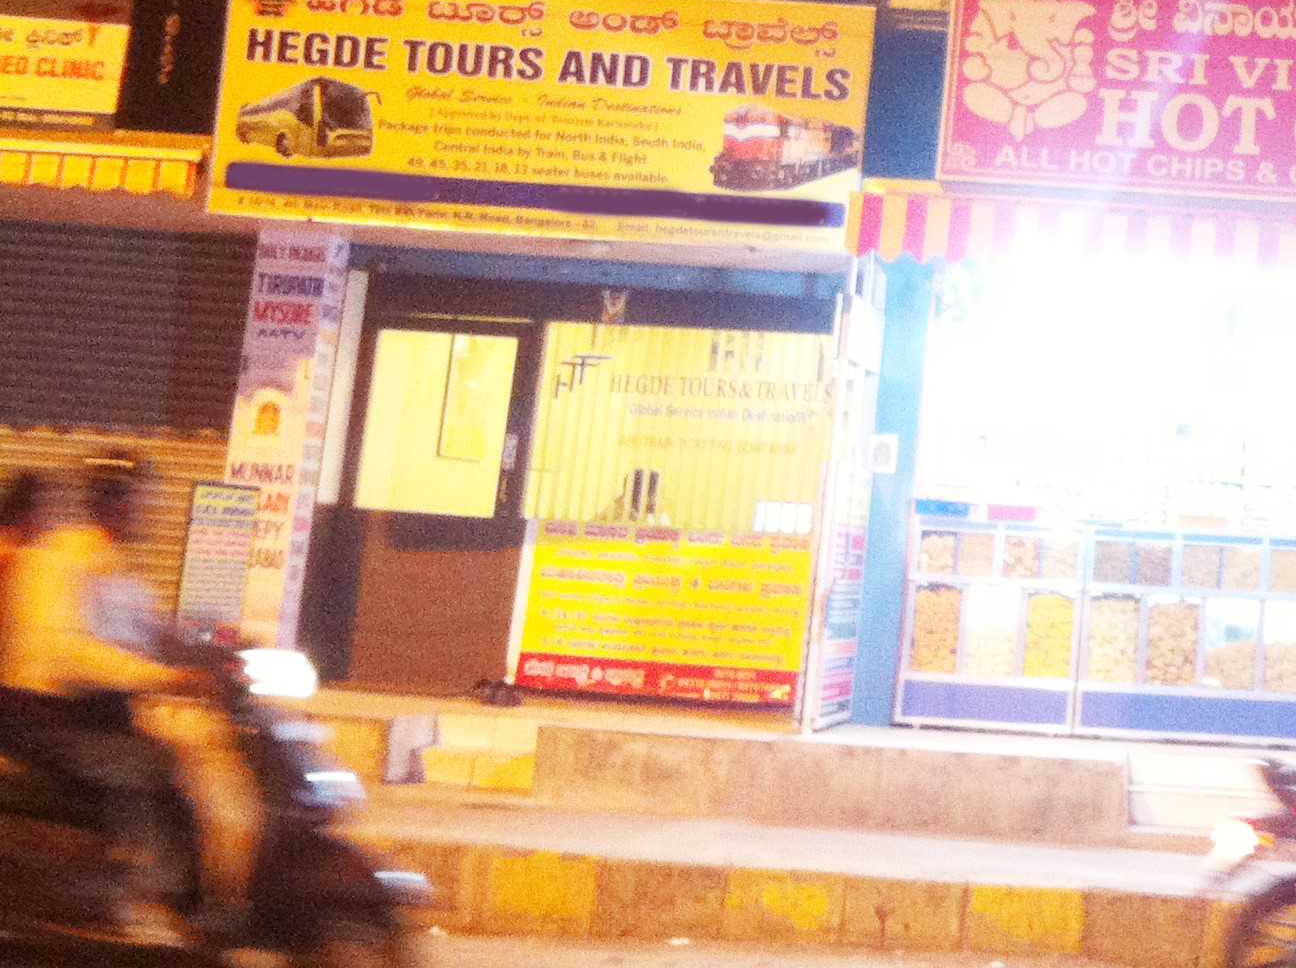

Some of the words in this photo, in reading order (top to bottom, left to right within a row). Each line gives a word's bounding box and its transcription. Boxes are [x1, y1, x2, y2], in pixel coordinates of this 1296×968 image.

[35, 57, 105, 81] CLINIC
[246, 27, 388, 71] HEGDE
[403, 39, 544, 80] TOURS
[557, 50, 650, 88] AND
[666, 56, 850, 101] TRAVELS
[1104, 47, 1211, 86] SRI
[378, 119, 429, 136] Package
[535, 129, 550, 140] for
[556, 132, 591, 143] North
[1095, 88, 1277, 155] HOT
[434, 139, 480, 153] Central
[484, 143, 513, 156] India
[518, 147, 531, 159] by
[573, 150, 595, 161] Bus
[612, 152, 647, 165] Flight
[994, 145, 1058, 171] ALL
[1069, 150, 1138, 174] HOT
[1147, 154, 1246, 181] CHIPS
[1255, 162, 1277, 182] &
[610, 374, 673, 395] HEGDE
[230, 462, 295, 482] MUNNAR
